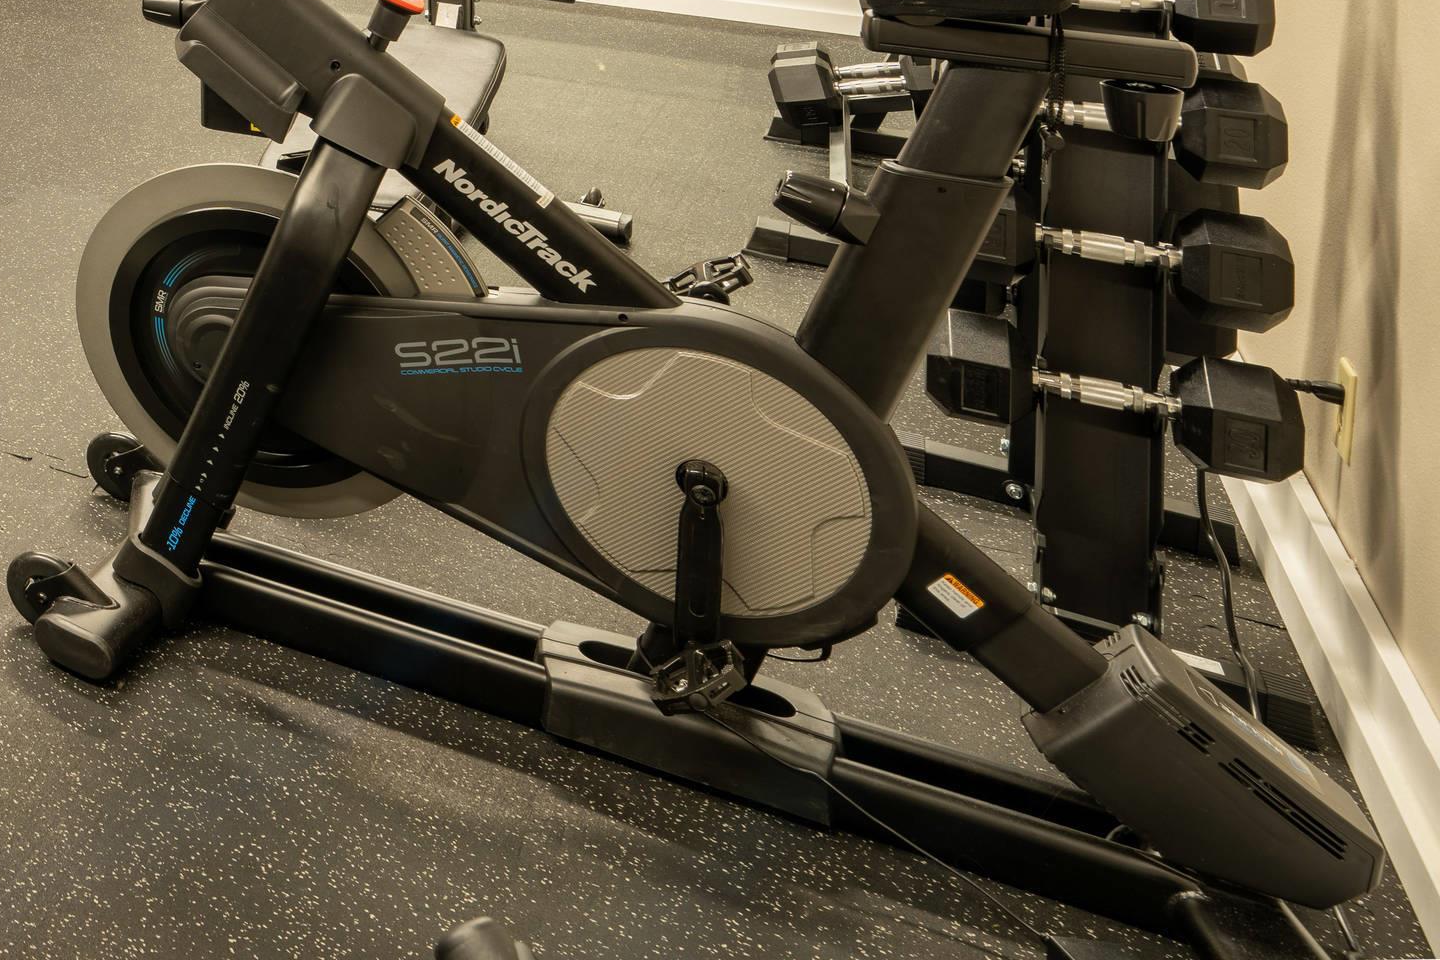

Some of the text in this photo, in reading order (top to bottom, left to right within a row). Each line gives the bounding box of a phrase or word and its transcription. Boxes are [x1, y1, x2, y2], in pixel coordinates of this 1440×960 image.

[421, 217, 439, 233] SMR
[433, 159, 597, 293] NordicTrack
[154, 289, 167, 313] SMR
[395, 336, 521, 368] S22i
[224, 380, 250, 431] INCLINE 20%
[166, 495, 197, 552] -10% DECLINE
